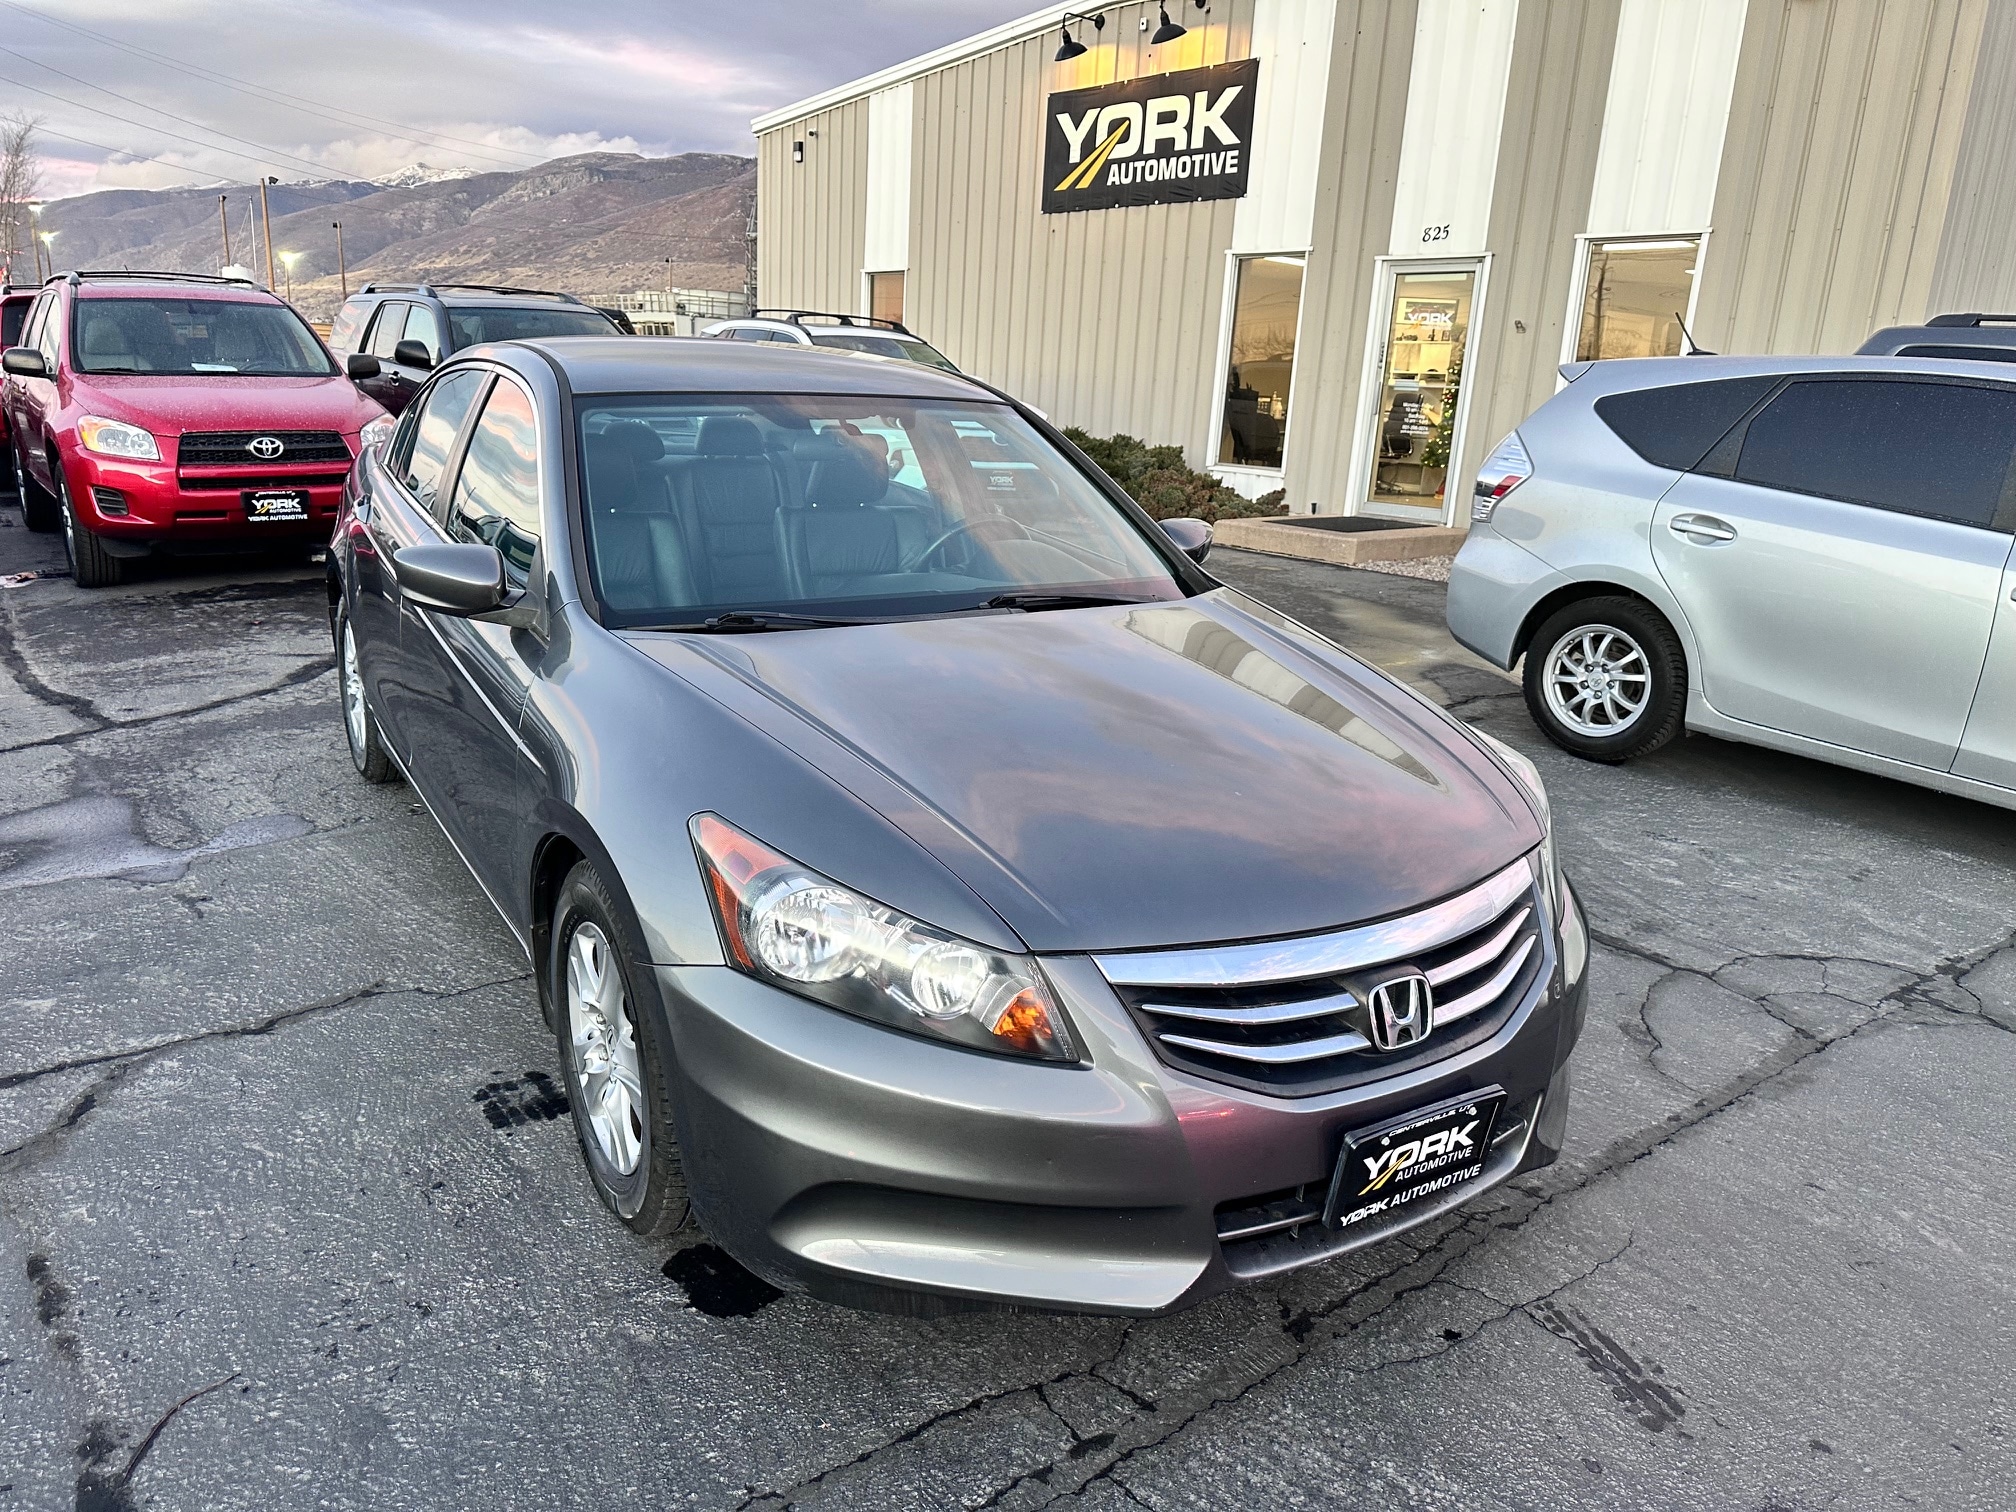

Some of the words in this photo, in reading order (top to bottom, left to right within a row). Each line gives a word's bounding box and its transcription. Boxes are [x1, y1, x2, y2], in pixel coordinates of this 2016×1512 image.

[1056, 85, 1243, 164] YORK
[1106, 149, 1240, 186] AUTOMOTIVE
[1422, 224, 1450, 242] 825
[1407, 312, 1454, 324] YORK
[251, 498, 301, 509] YORK
[1388, 1109, 1456, 1137] CENTERVILLE
[1363, 1119, 1480, 1180] YORK
[1395, 1146, 1473, 1182] AUTOMOTIVE
[1340, 1197, 1390, 1227] YORK
[1390, 1164, 1482, 1207] AUTOMOTIVE
